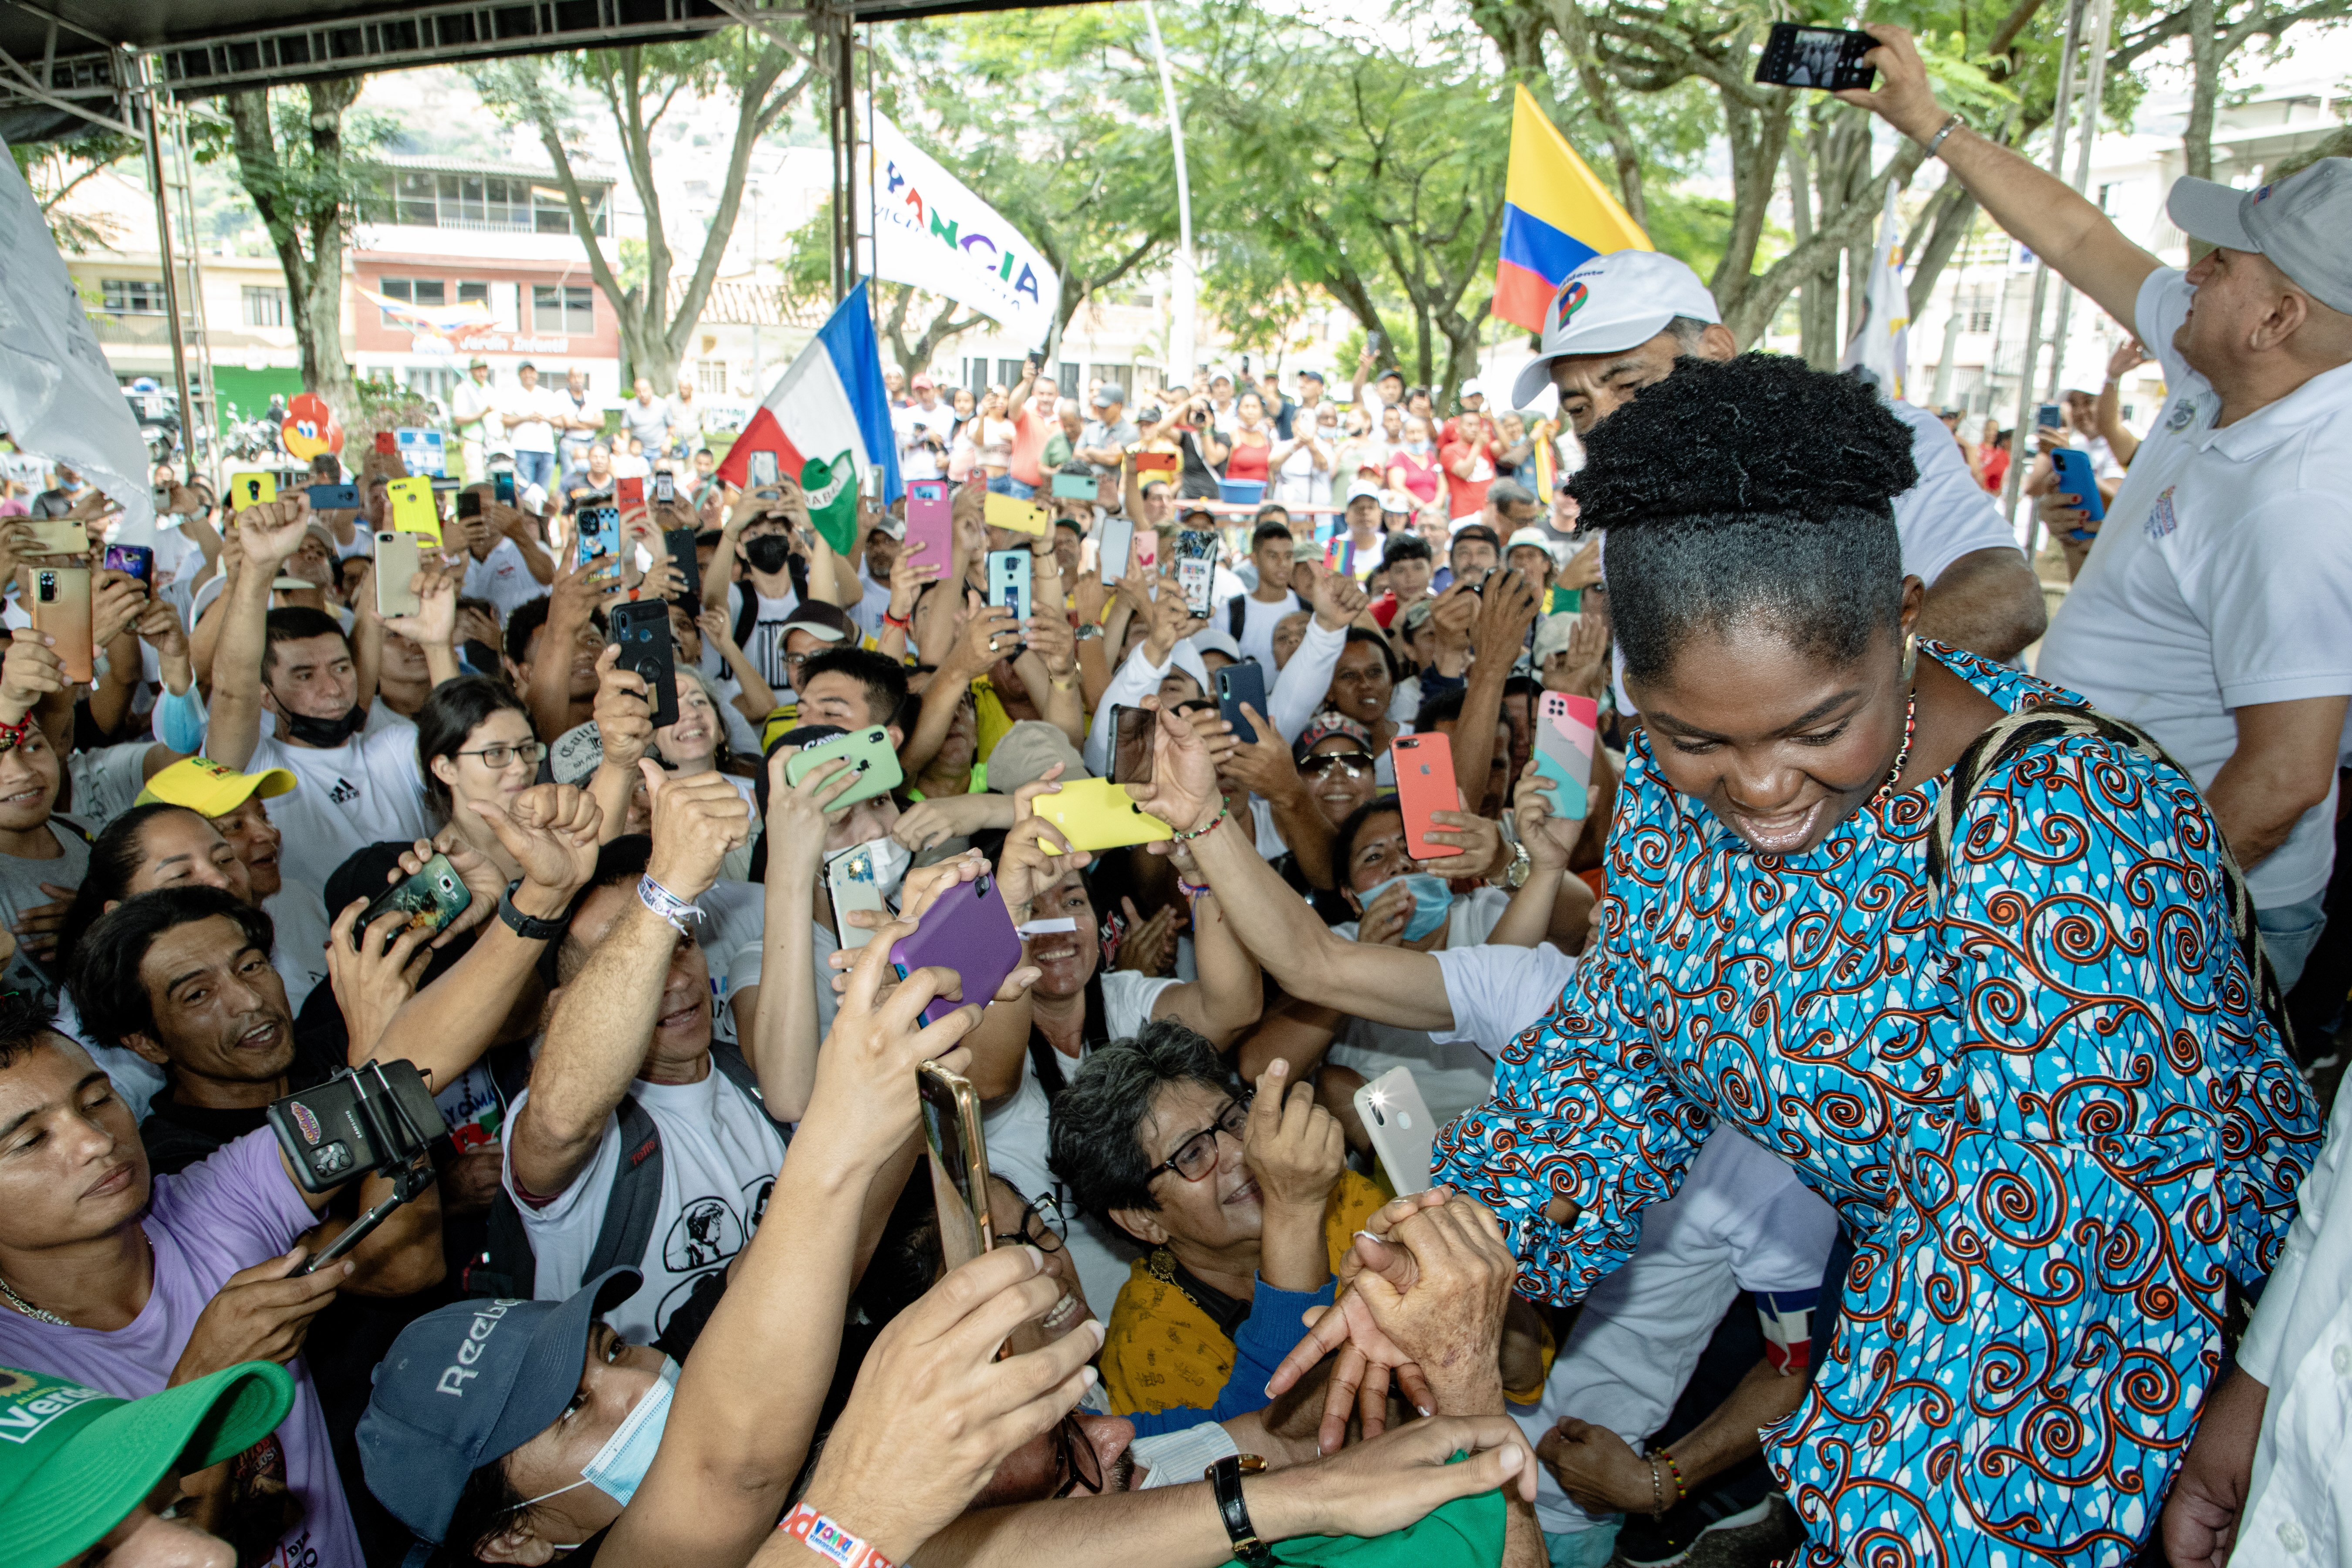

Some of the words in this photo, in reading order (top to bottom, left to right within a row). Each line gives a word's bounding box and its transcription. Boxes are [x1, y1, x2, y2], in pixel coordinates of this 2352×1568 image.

[871, 159, 1039, 305] RANCIA
[345, 1110, 363, 1139] SAMSUNG
[436, 1298, 528, 1397] Reebo
[809, 1533, 849, 1563] VICEPRESIDENTA
